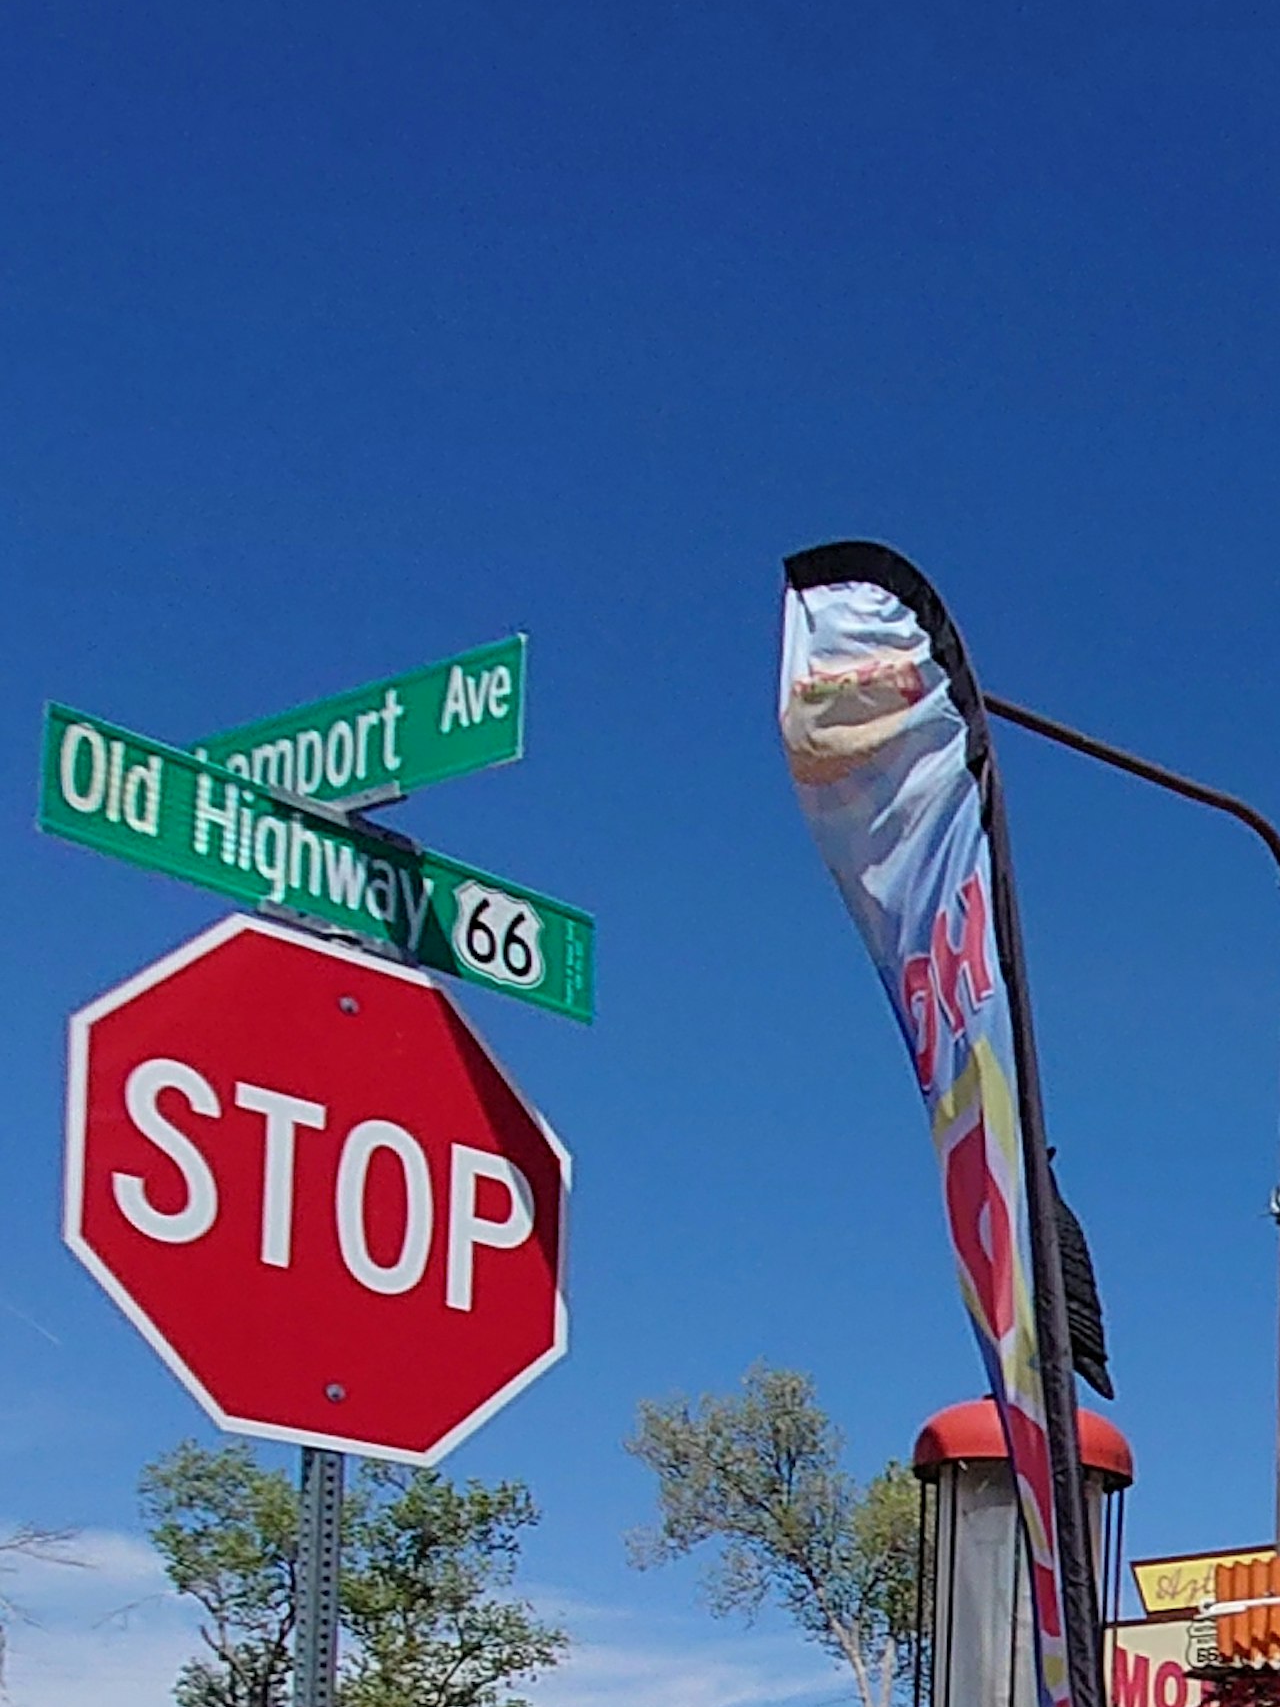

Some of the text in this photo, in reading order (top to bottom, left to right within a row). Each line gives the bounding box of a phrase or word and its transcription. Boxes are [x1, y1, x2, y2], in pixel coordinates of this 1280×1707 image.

[60, 722, 163, 837] Old
[192, 772, 434, 951] Highway
[467, 899, 533, 978] 66
[196, 665, 513, 796] mport Ave
[112, 1058, 535, 1312] STOP
